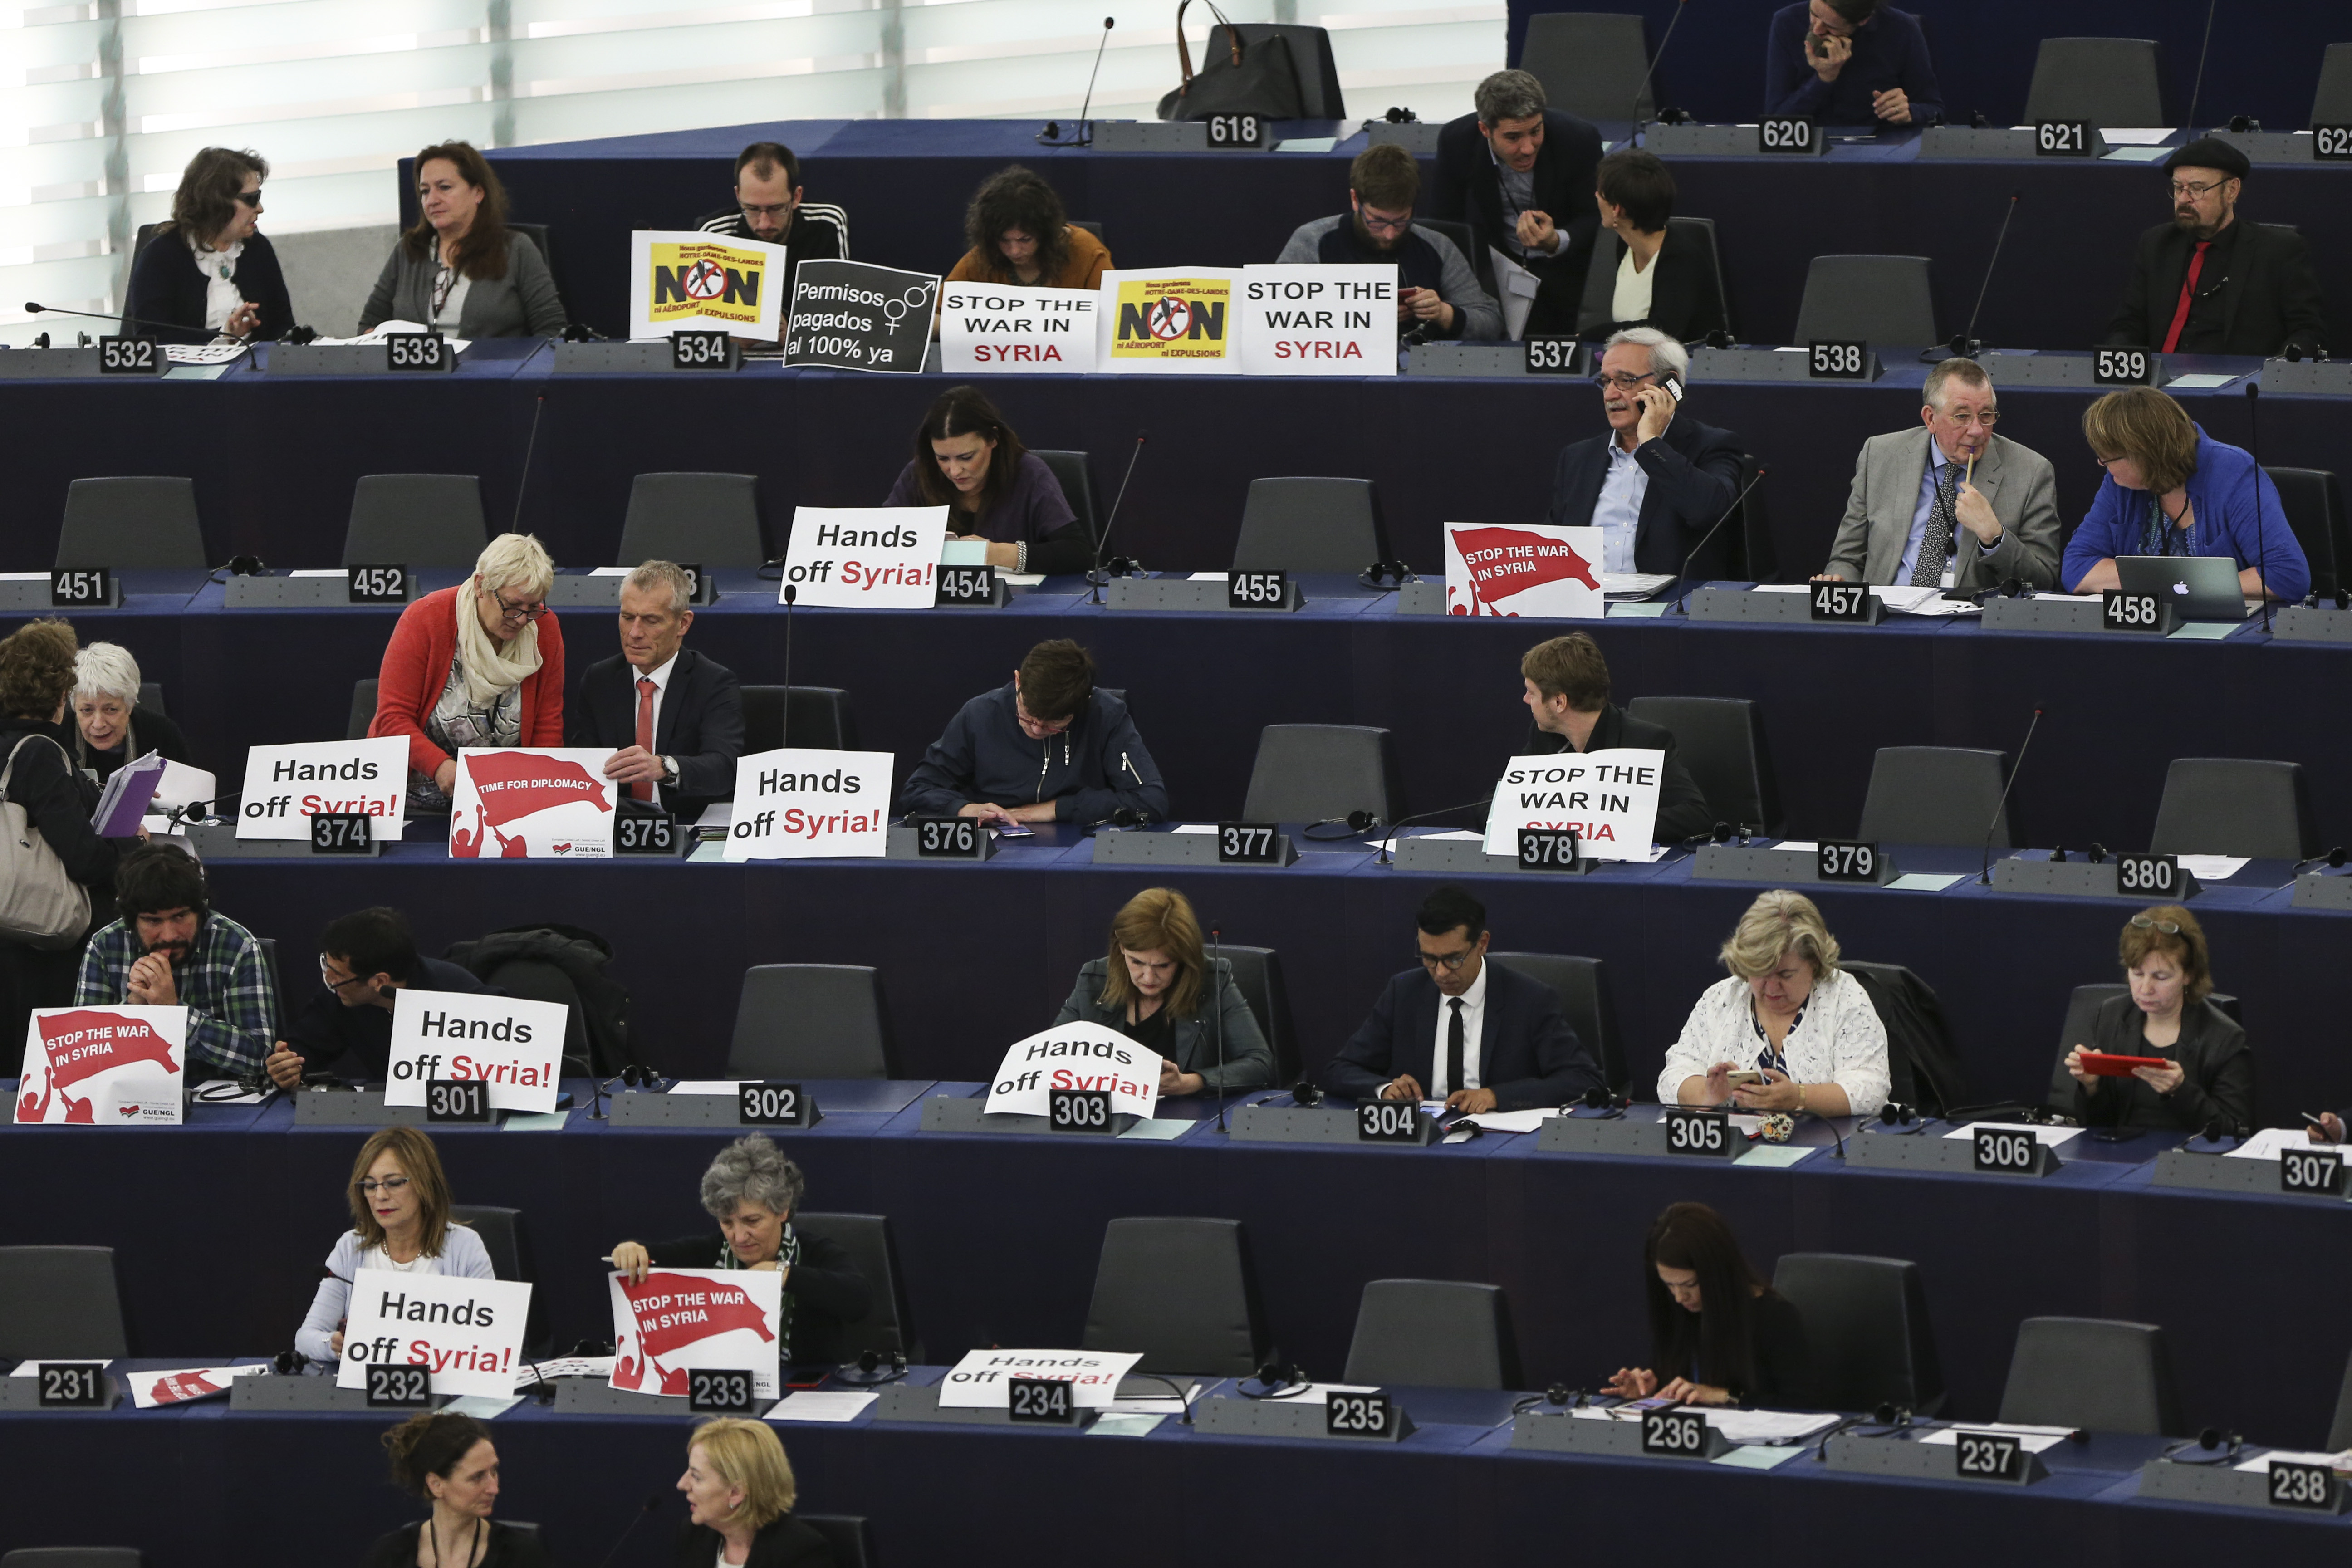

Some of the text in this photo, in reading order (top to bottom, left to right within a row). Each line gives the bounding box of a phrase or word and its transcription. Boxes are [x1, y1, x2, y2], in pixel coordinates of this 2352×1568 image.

[1211, 116, 1257, 141] 618
[1764, 121, 1808, 146] 620
[2041, 124, 2082, 149] 621
[2318, 128, 2352, 153] 62
[797, 283, 884, 306] Permisos
[947, 296, 1091, 311] STOP THE
[1248, 282, 1391, 299] STOP THE
[662, 301, 701, 313] AÉROPORT
[705, 309, 755, 323] EXPULSIONS
[1265, 311, 1370, 328] WAR IN
[792, 311, 872, 332] pagados
[965, 318, 1069, 332] WAR IN
[105, 341, 152, 367] 532
[393, 338, 439, 364] 533
[678, 336, 725, 362] 534
[788, 336, 893, 364] al 100% ya
[975, 345, 1061, 361] SYRIA
[1276, 342, 1361, 358] SYRIA
[1530, 341, 1576, 367] 537
[1815, 345, 1860, 372] 538
[2099, 351, 2145, 378] 539
[817, 525, 917, 547] Hands
[1466, 546, 1568, 564] STOP THE WAR
[354, 569, 402, 595] 452
[789, 561, 932, 590] off Syria!
[942, 571, 990, 597] 454
[1478, 561, 1536, 581] IN SYRIA
[57, 573, 101, 598] 451
[1234, 574, 1280, 601] 455
[1816, 587, 1863, 614] 457
[2109, 596, 2156, 623] 458
[274, 758, 377, 782] Hands
[760, 769, 860, 796] Hands
[1507, 766, 1655, 785] STOP THE
[478, 779, 592, 794] TIME FOR DIPLOMACY
[245, 796, 291, 818] off
[1521, 792, 1629, 813] WAR IN
[317, 819, 366, 846] 374
[621, 819, 669, 846] 375
[734, 808, 880, 839] off Syria!
[924, 822, 972, 850] 376
[1224, 828, 1272, 855] 377
[1524, 835, 1572, 863] 378
[1824, 846, 1872, 875] 379
[2123, 859, 2171, 889] 380
[47, 1025, 149, 1050] STOP THE WAR
[422, 1011, 532, 1043] Hands
[55, 1042, 113, 1067] IN SYRIA
[1026, 1041, 1131, 1064] Hands
[393, 1054, 441, 1080] off
[996, 1071, 1042, 1094] off
[432, 1086, 479, 1115] 301
[745, 1089, 795, 1117] 302
[1056, 1096, 1105, 1125] 303
[1364, 1105, 1414, 1134] 304
[1672, 1118, 1721, 1149] 305
[1980, 1135, 2029, 1166] 306
[2287, 1156, 2336, 1187] 307
[380, 1292, 493, 1327] Hands
[633, 1292, 745, 1313] STOP THE WAR
[643, 1309, 708, 1332] IN SYRIA
[348, 1337, 399, 1363] off
[407, 1340, 511, 1373] Syria!
[988, 1357, 1101, 1367] Hands
[45, 1370, 93, 1399] 231
[372, 1371, 425, 1400] 232
[951, 1371, 1002, 1382] off
[695, 1376, 746, 1406] 233
[1014, 1385, 1066, 1415] 234
[1333, 1398, 1384, 1430] 235
[1648, 1416, 1699, 1449] 236
[1962, 1440, 2013, 1472] 237
[2274, 1468, 2325, 1502] 238
